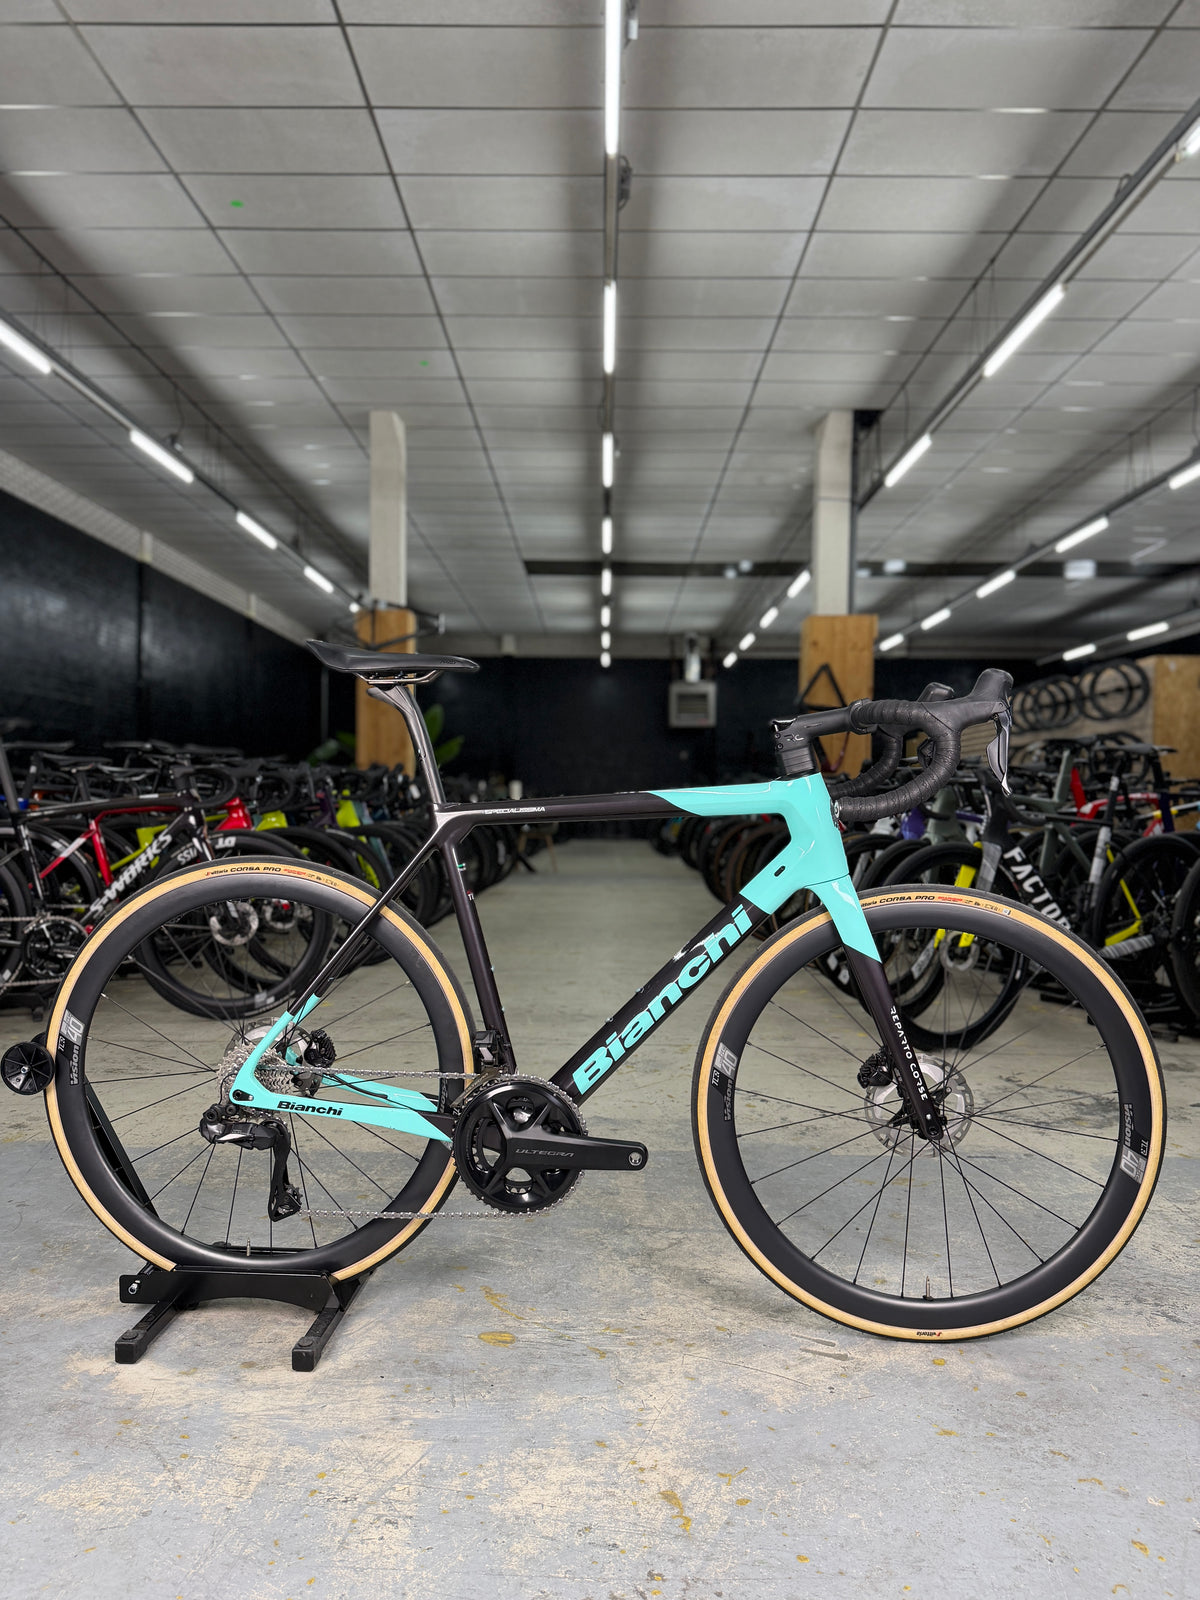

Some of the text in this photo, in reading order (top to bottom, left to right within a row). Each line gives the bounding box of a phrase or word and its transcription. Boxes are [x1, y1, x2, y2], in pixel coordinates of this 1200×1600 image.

[89, 833, 173, 918] S-WORKS
[879, 895, 912, 904] CORSA
[572, 904, 753, 1096] Bianchi
[67, 1016, 84, 1042] 40
[721, 1049, 739, 1076] 40
[890, 1005, 928, 1101] REPARTO CORSE
[277, 1100, 344, 1116] Bianchi
[515, 1148, 575, 1158] ULTEGRA
[1121, 1150, 1139, 1178] 40
